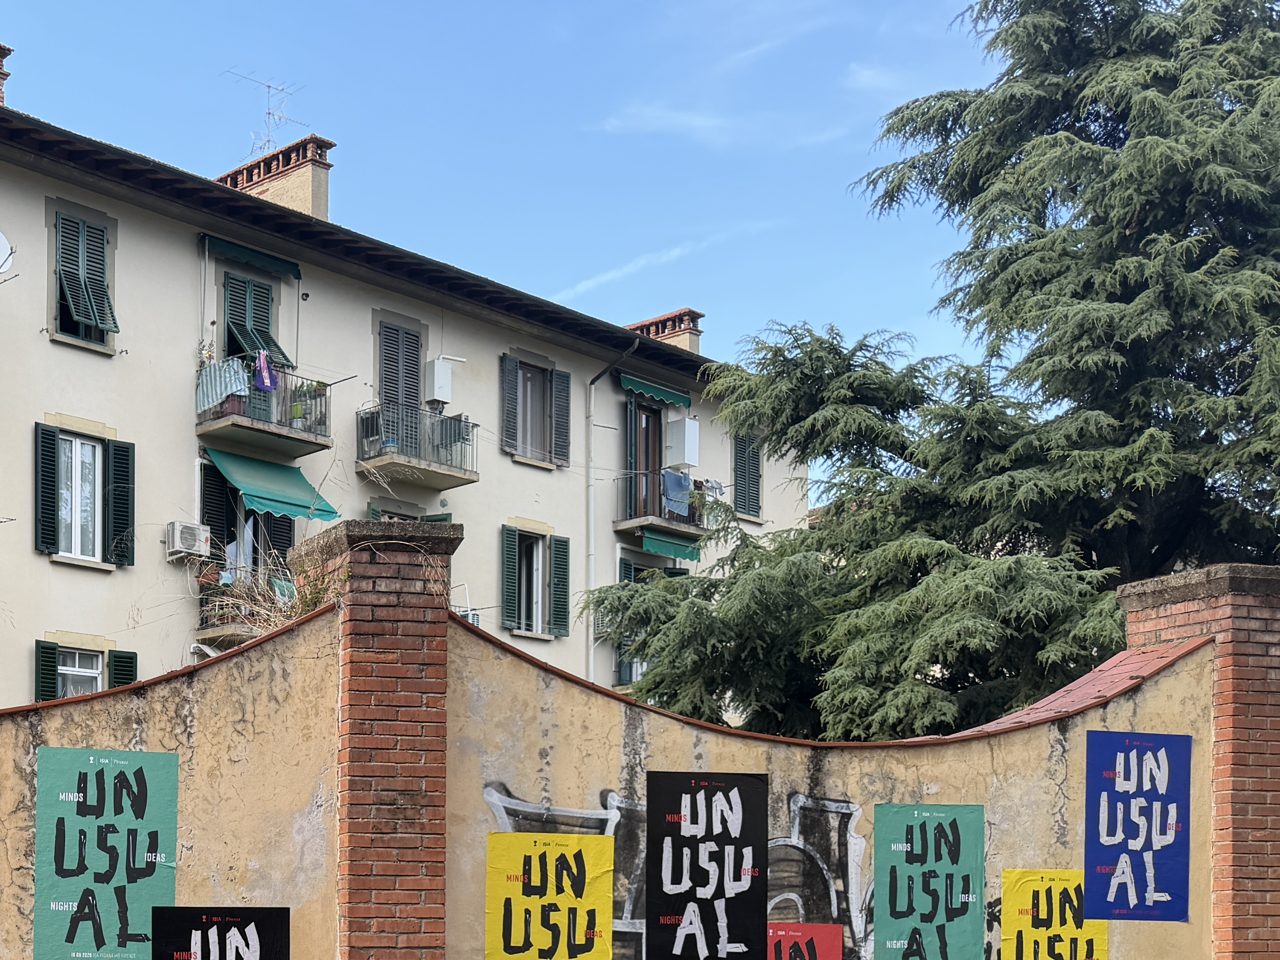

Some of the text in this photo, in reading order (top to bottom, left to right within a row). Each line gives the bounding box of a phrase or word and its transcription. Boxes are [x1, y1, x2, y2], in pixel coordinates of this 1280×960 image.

[76, 766, 148, 820] UN
[1114, 747, 1169, 795] UN
[59, 792, 84, 802] MINDS
[665, 814, 688, 823] MINDS
[680, 786, 743, 839] UN
[1099, 791, 1177, 851] USU
[54, 817, 158, 885] USU
[144, 853, 166, 862] IDEAS
[891, 843, 912, 851] MINDS
[904, 817, 961, 867] UN
[506, 874, 529, 883] MINDS
[522, 848, 586, 900] UN
[661, 836, 753, 899] USU
[1106, 850, 1172, 910] AL
[50, 902, 78, 911] NIGHTS
[65, 885, 152, 952] AL
[888, 865, 970, 924] USU
[959, 894, 977, 902] IDEAS
[1031, 883, 1084, 931] UN
[502, 897, 596, 960] USU
[584, 930, 603, 938] IDEAS
[659, 916, 683, 924] NIGHTS
[173, 951, 198, 960] MINDS
[886, 940, 908, 949] NIGHTS
